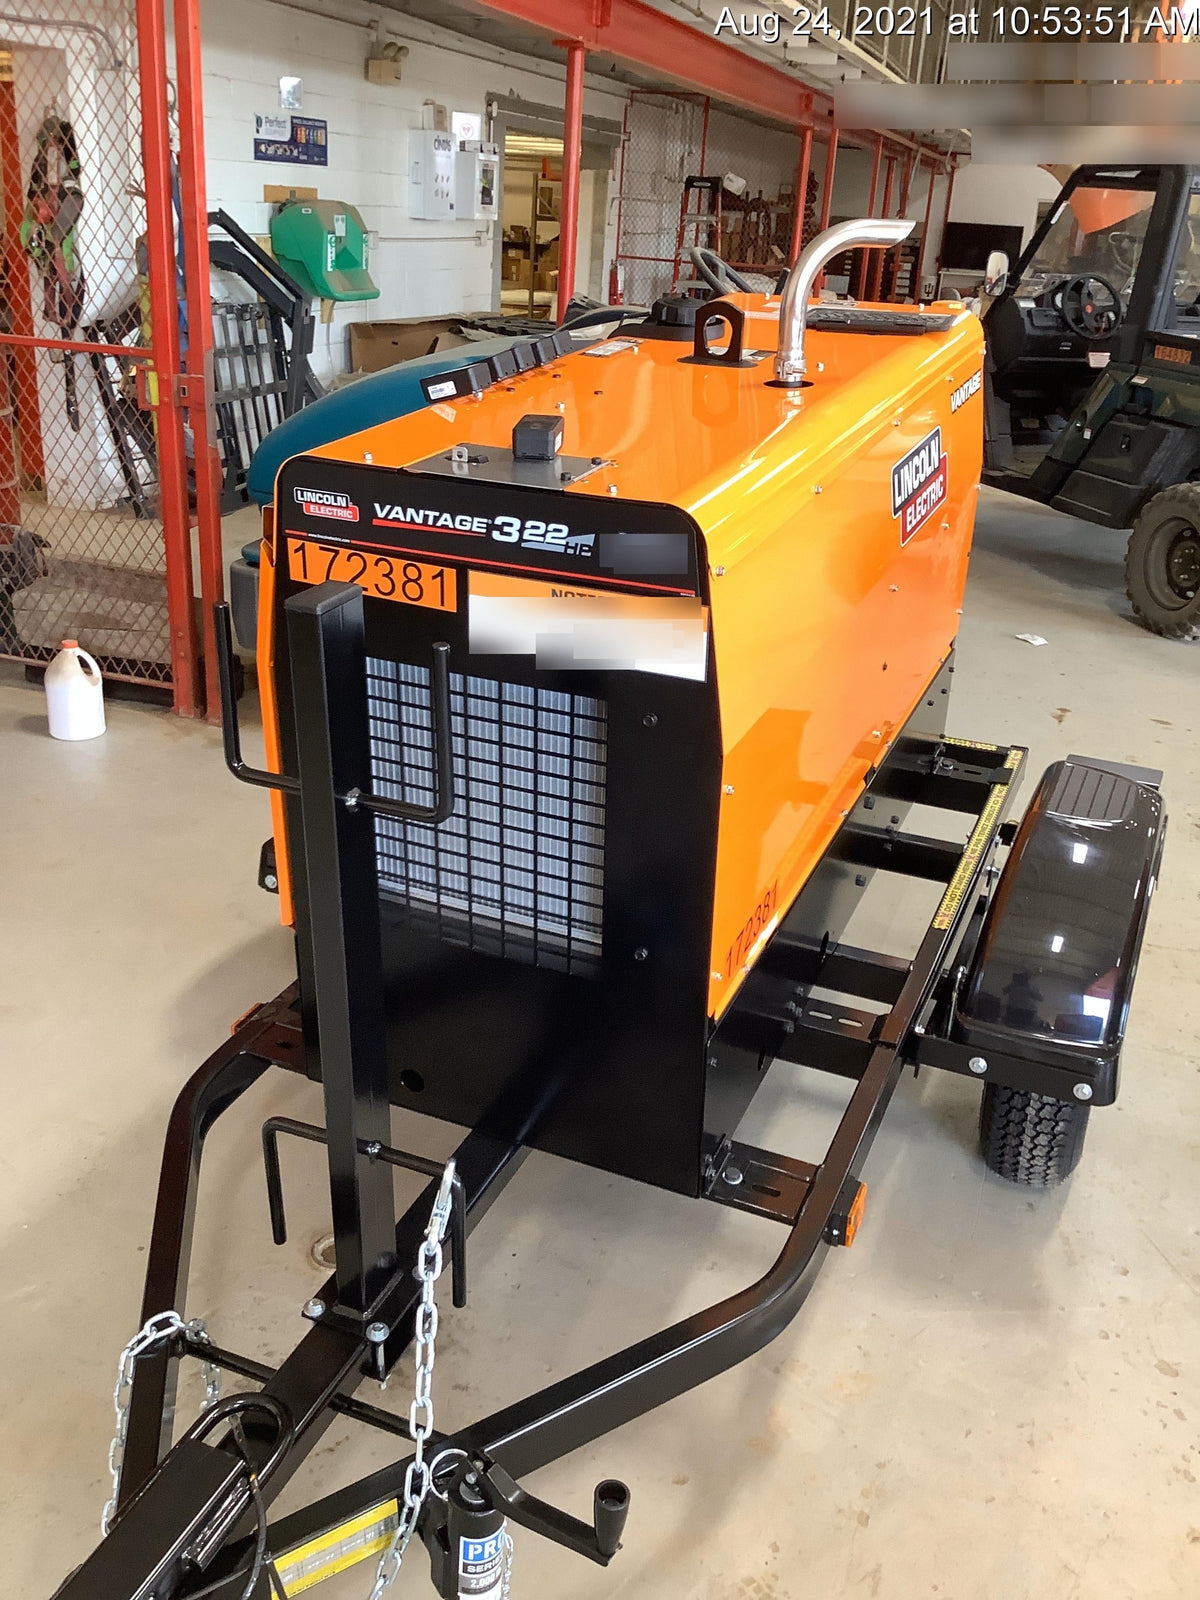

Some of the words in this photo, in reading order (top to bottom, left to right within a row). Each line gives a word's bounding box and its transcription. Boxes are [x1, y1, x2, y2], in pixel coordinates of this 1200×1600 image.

[894, 436, 939, 508] LINCOLN
[297, 490, 347, 507] LINCOLN
[309, 504, 354, 519] ELECTRIC
[373, 503, 488, 533] VANTAGE
[906, 473, 944, 533] ELECTRIC
[293, 542, 446, 607] 172381
[949, 891, 958, 903] NOT
[726, 878, 778, 978] 172381
